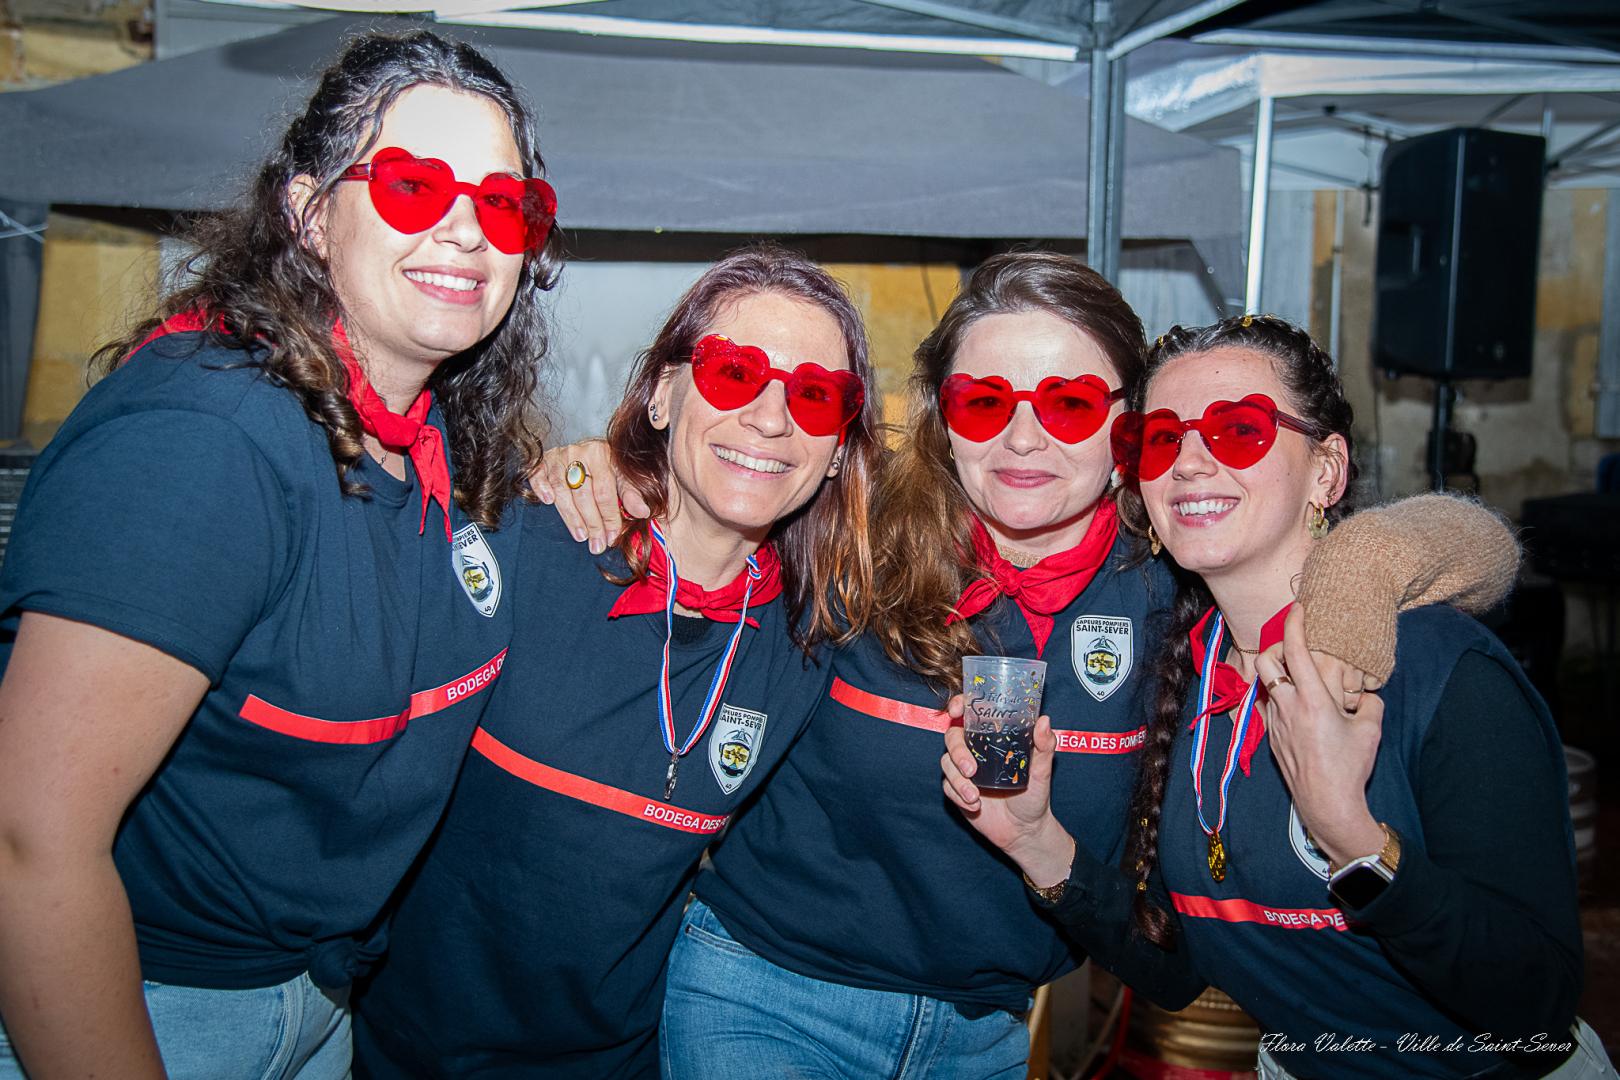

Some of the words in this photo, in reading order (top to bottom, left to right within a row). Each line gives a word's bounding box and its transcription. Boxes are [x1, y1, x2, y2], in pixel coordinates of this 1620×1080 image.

[484, 605, 492, 613] 40
[1076, 624, 1130, 636] SAINT-SEVER
[1102, 620, 1129, 628] POMPIERS
[446, 664, 496, 701] BODEGA
[977, 707, 1018, 719] SAINT
[1091, 737, 1117, 750] DES
[643, 803, 700, 830] BODEGA
[701, 818, 721, 830] DES
[1263, 910, 1322, 925] BODEGA
